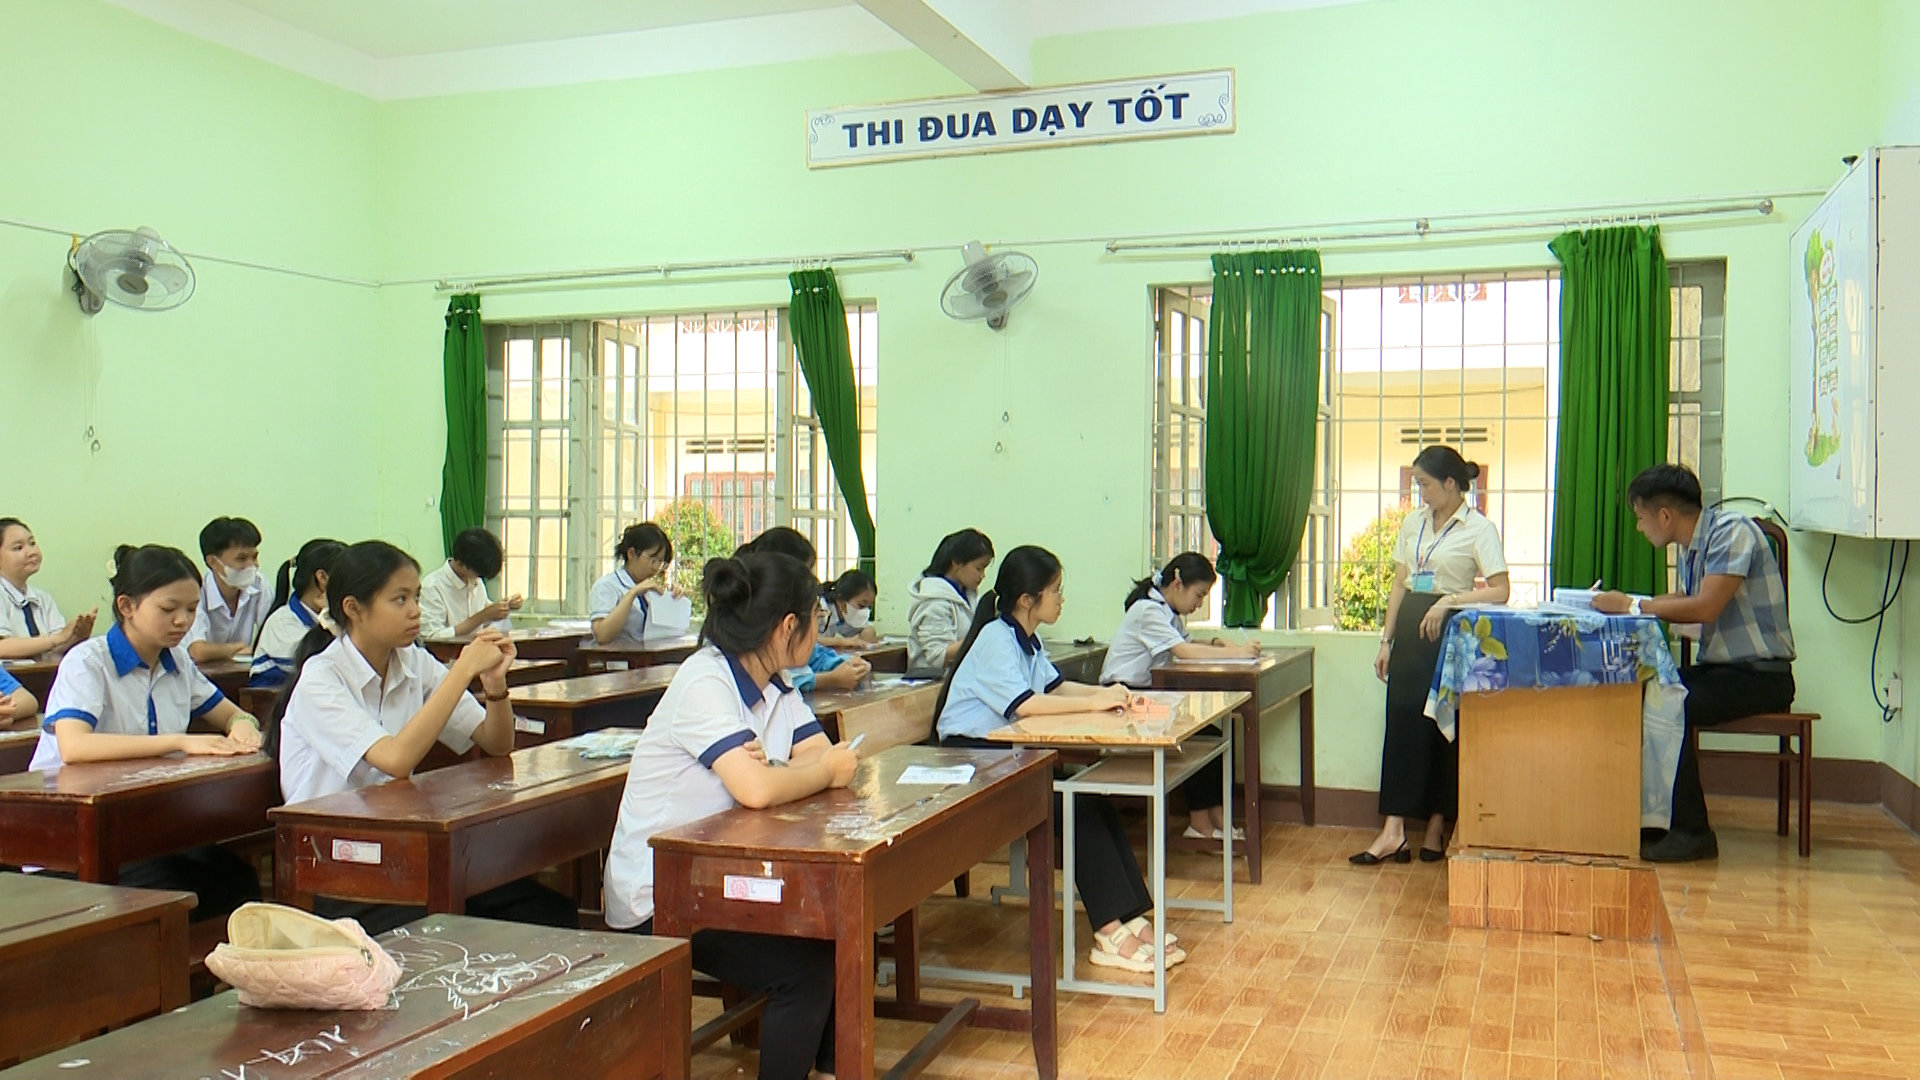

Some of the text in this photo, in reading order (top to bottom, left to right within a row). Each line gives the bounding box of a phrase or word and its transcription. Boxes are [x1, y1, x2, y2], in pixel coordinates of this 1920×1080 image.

[841, 83, 1190, 148] THI ĐUA DẠY TỐT
